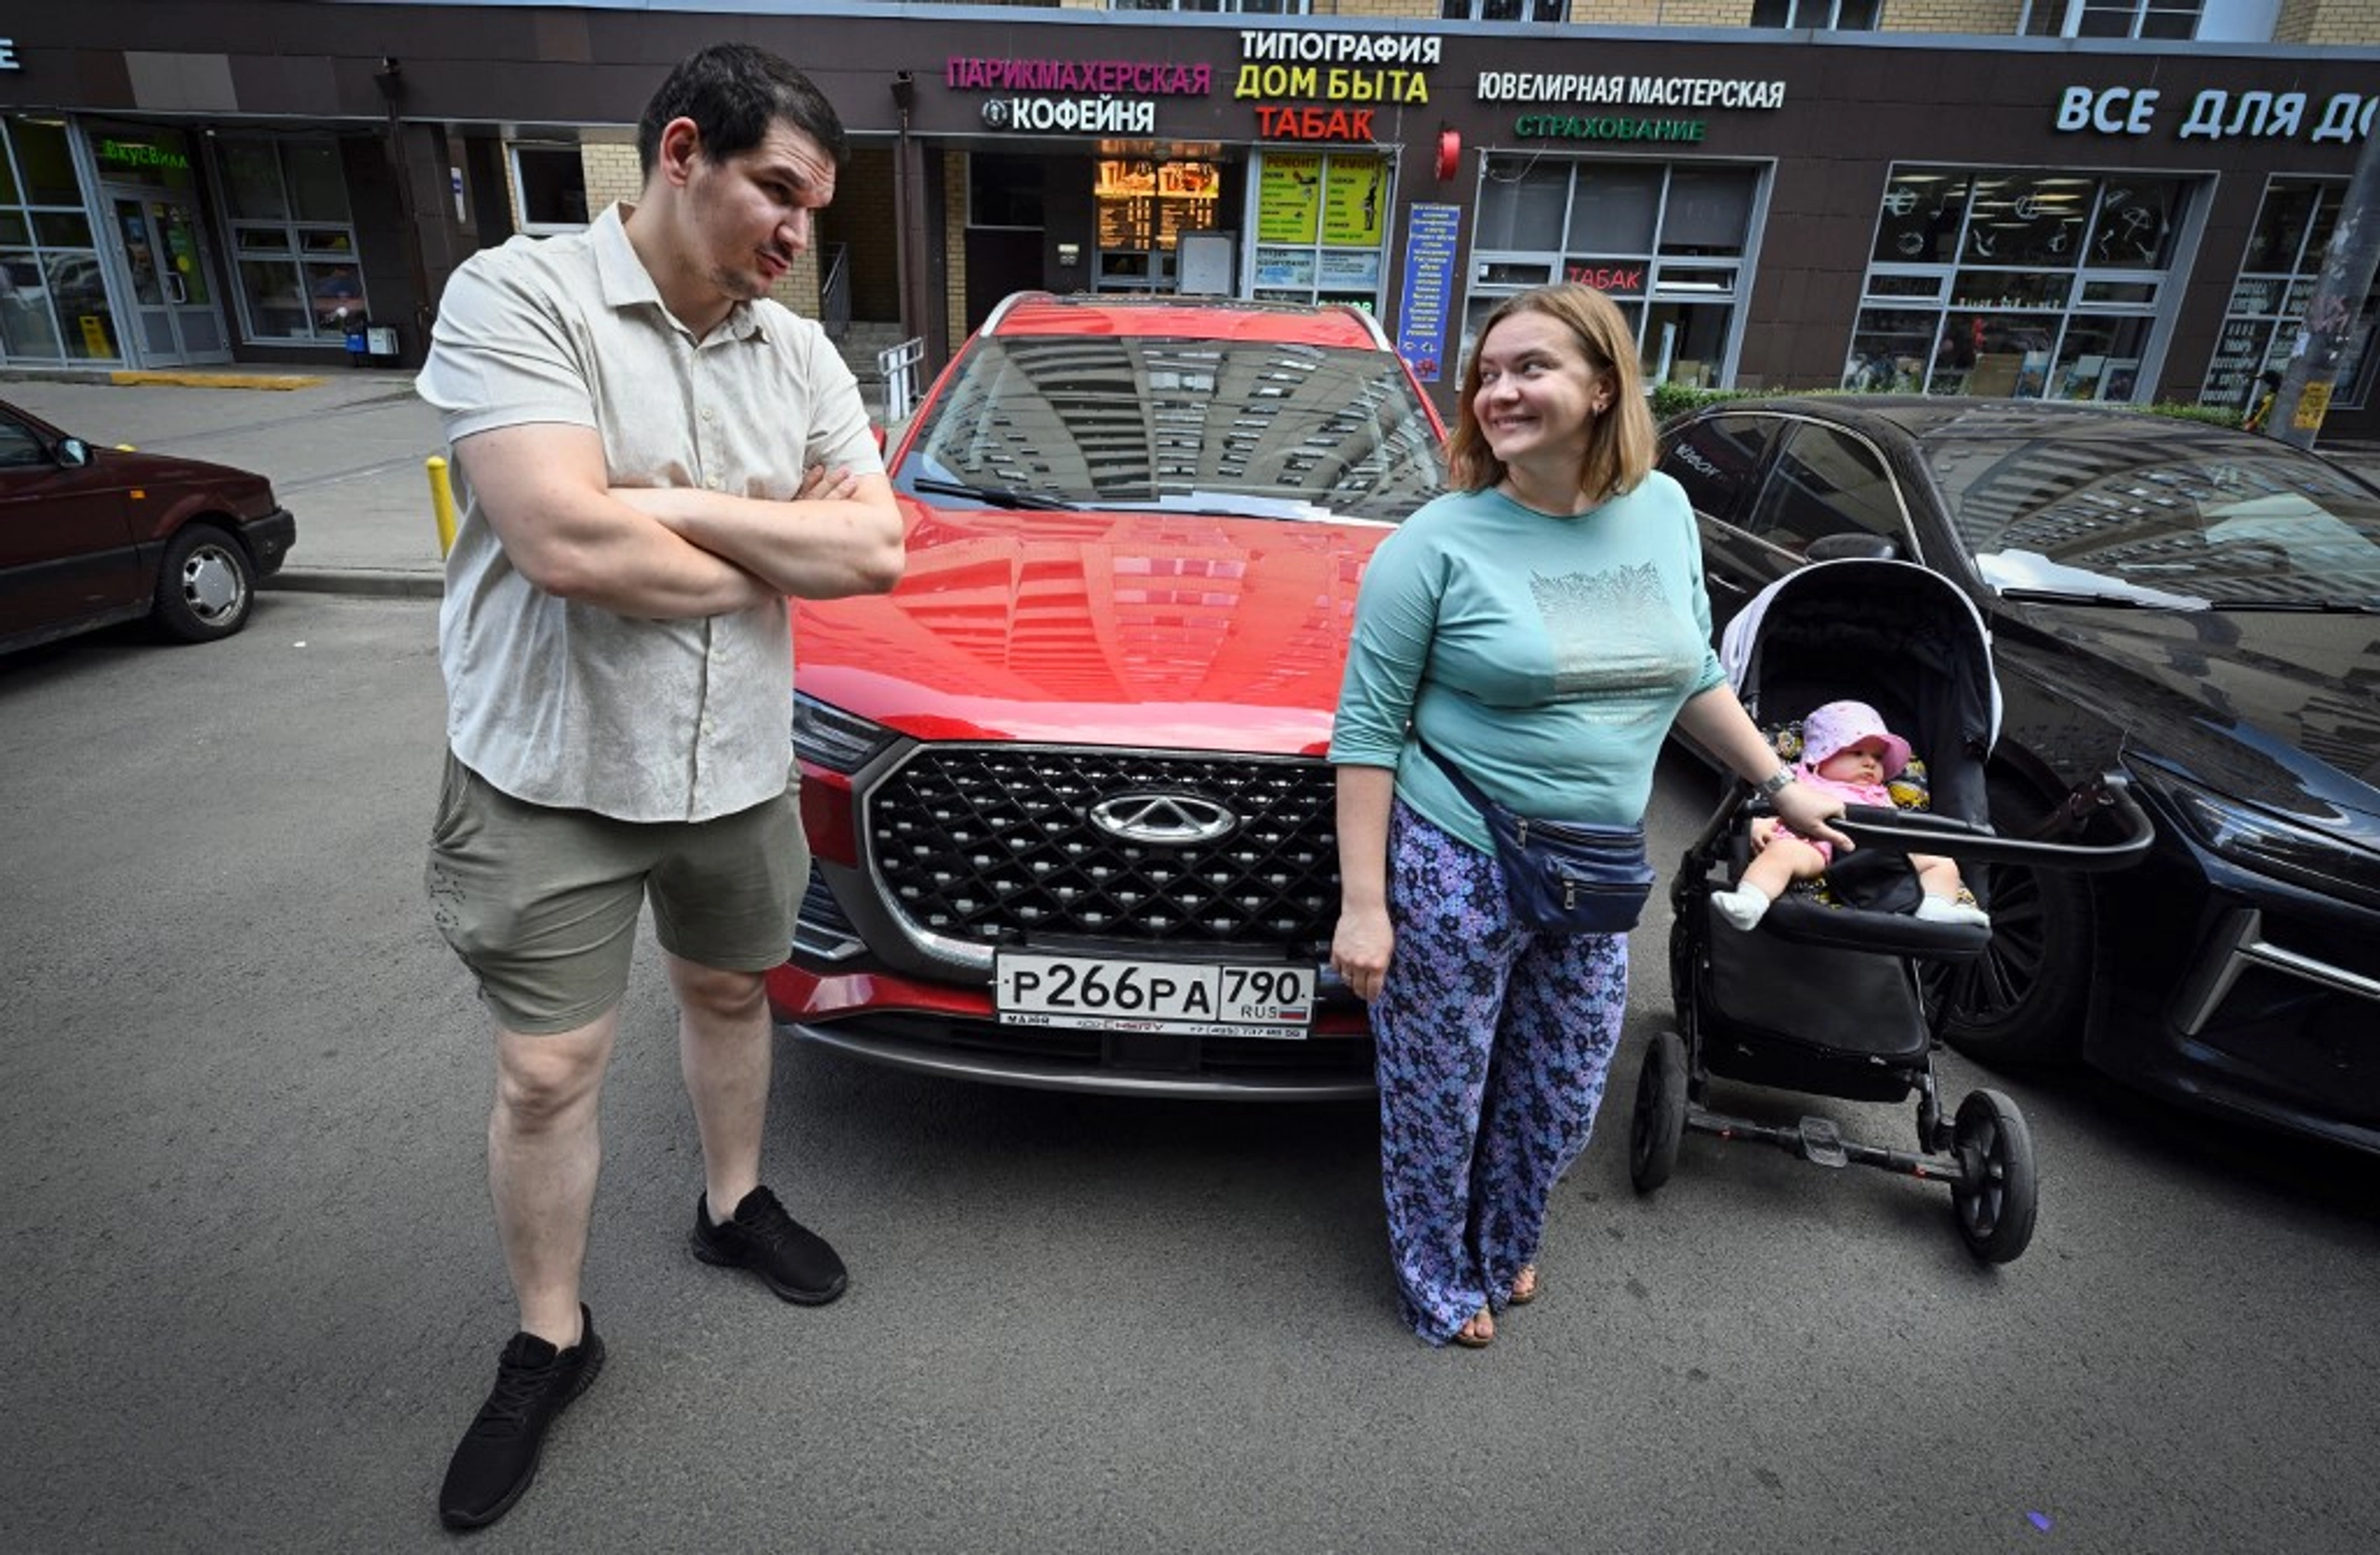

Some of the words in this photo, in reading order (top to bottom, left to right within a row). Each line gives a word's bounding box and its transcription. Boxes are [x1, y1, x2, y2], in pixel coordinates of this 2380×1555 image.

[1241, 31, 1441, 63] ТИПОГРАФИЯ
[945, 58, 1211, 94] ПАРИКМАХЕРСКАЯ
[1234, 65, 1316, 99] ДОМ
[1327, 70, 1429, 104] БЫТА
[1477, 72, 1624, 104] ЮВЕЛИРНАЯ
[1628, 75, 1786, 109] МАСТЕРСКАЯ
[1012, 94, 1156, 133] КОФЕЙНЯ
[1256, 107, 1374, 139] ТАБАК
[1514, 114, 1707, 142] СТРАХОВАНИЕ
[2056, 86, 2161, 135] ВСЕ
[2180, 90, 2307, 140] ДЛЯ
[1569, 267, 1642, 290] ТАБАК
[1012, 964, 1210, 1014] Р266РА
[1224, 969, 1302, 1006] 790
[1240, 1005, 1277, 1020] RUS
